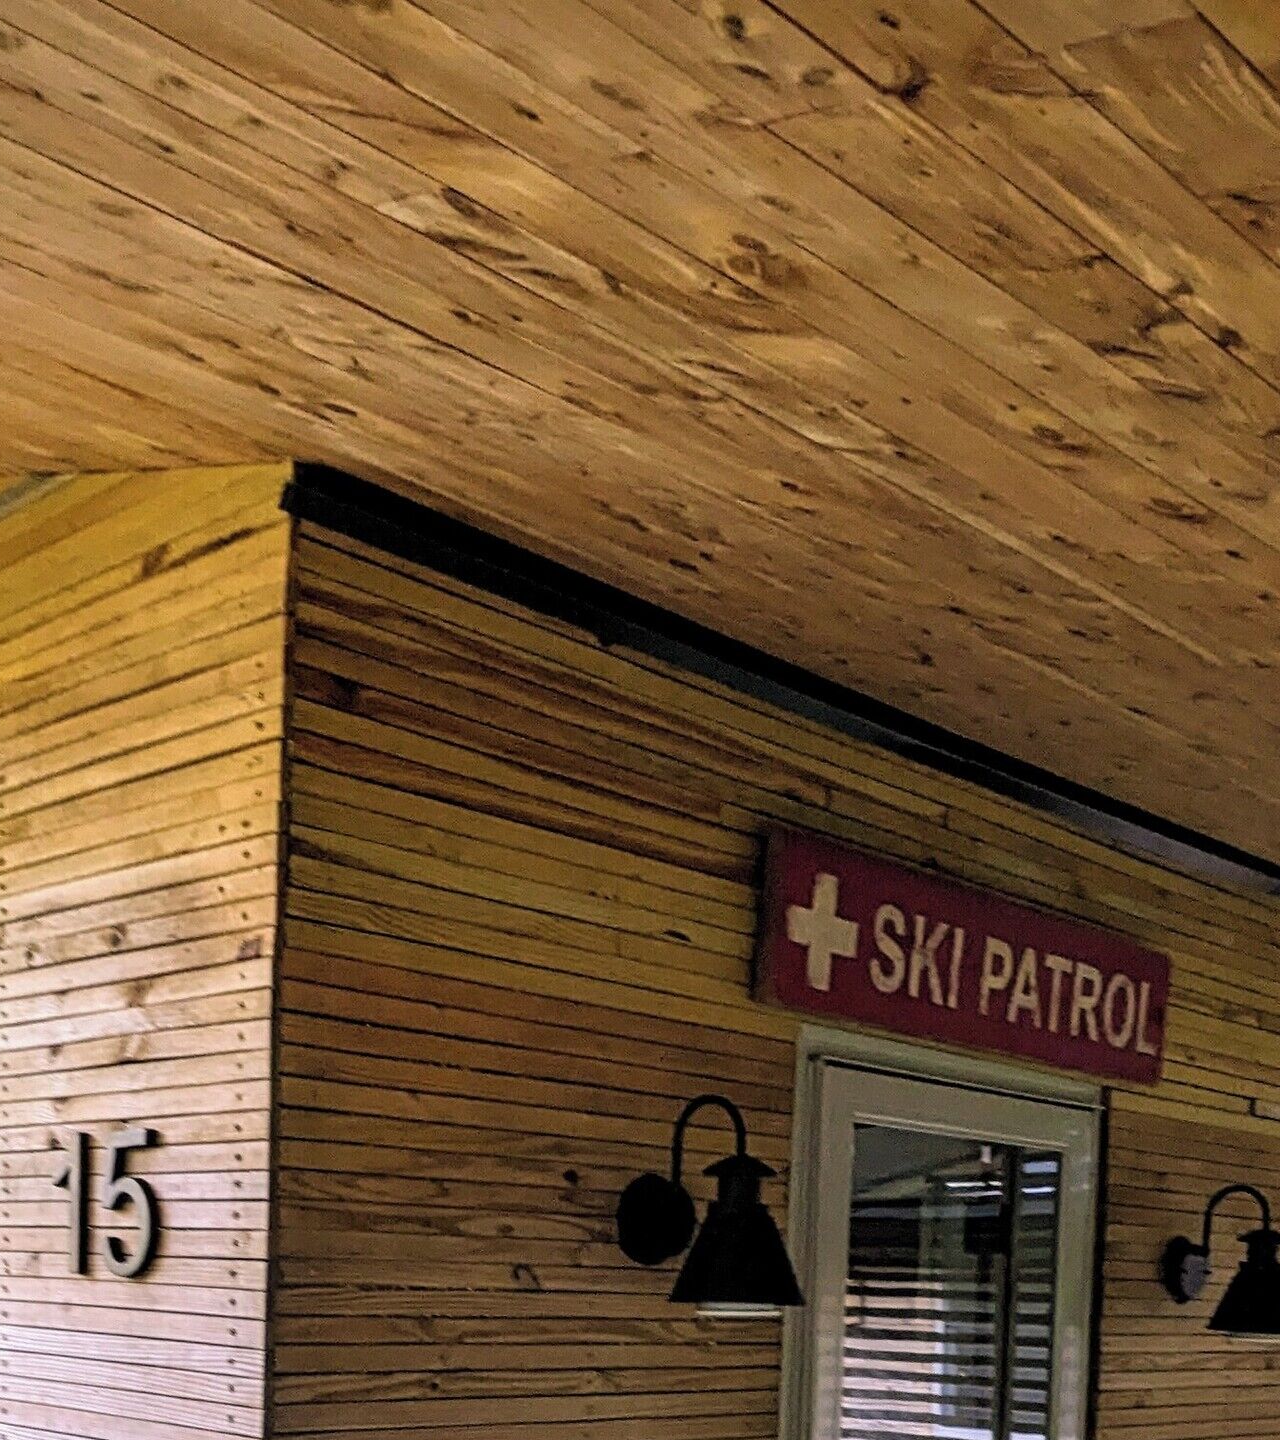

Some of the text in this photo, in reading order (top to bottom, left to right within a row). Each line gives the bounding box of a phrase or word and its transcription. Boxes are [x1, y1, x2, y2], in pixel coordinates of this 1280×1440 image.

[869, 903, 1158, 1057] SKI PATROL
[52, 1127, 161, 1278] 15
